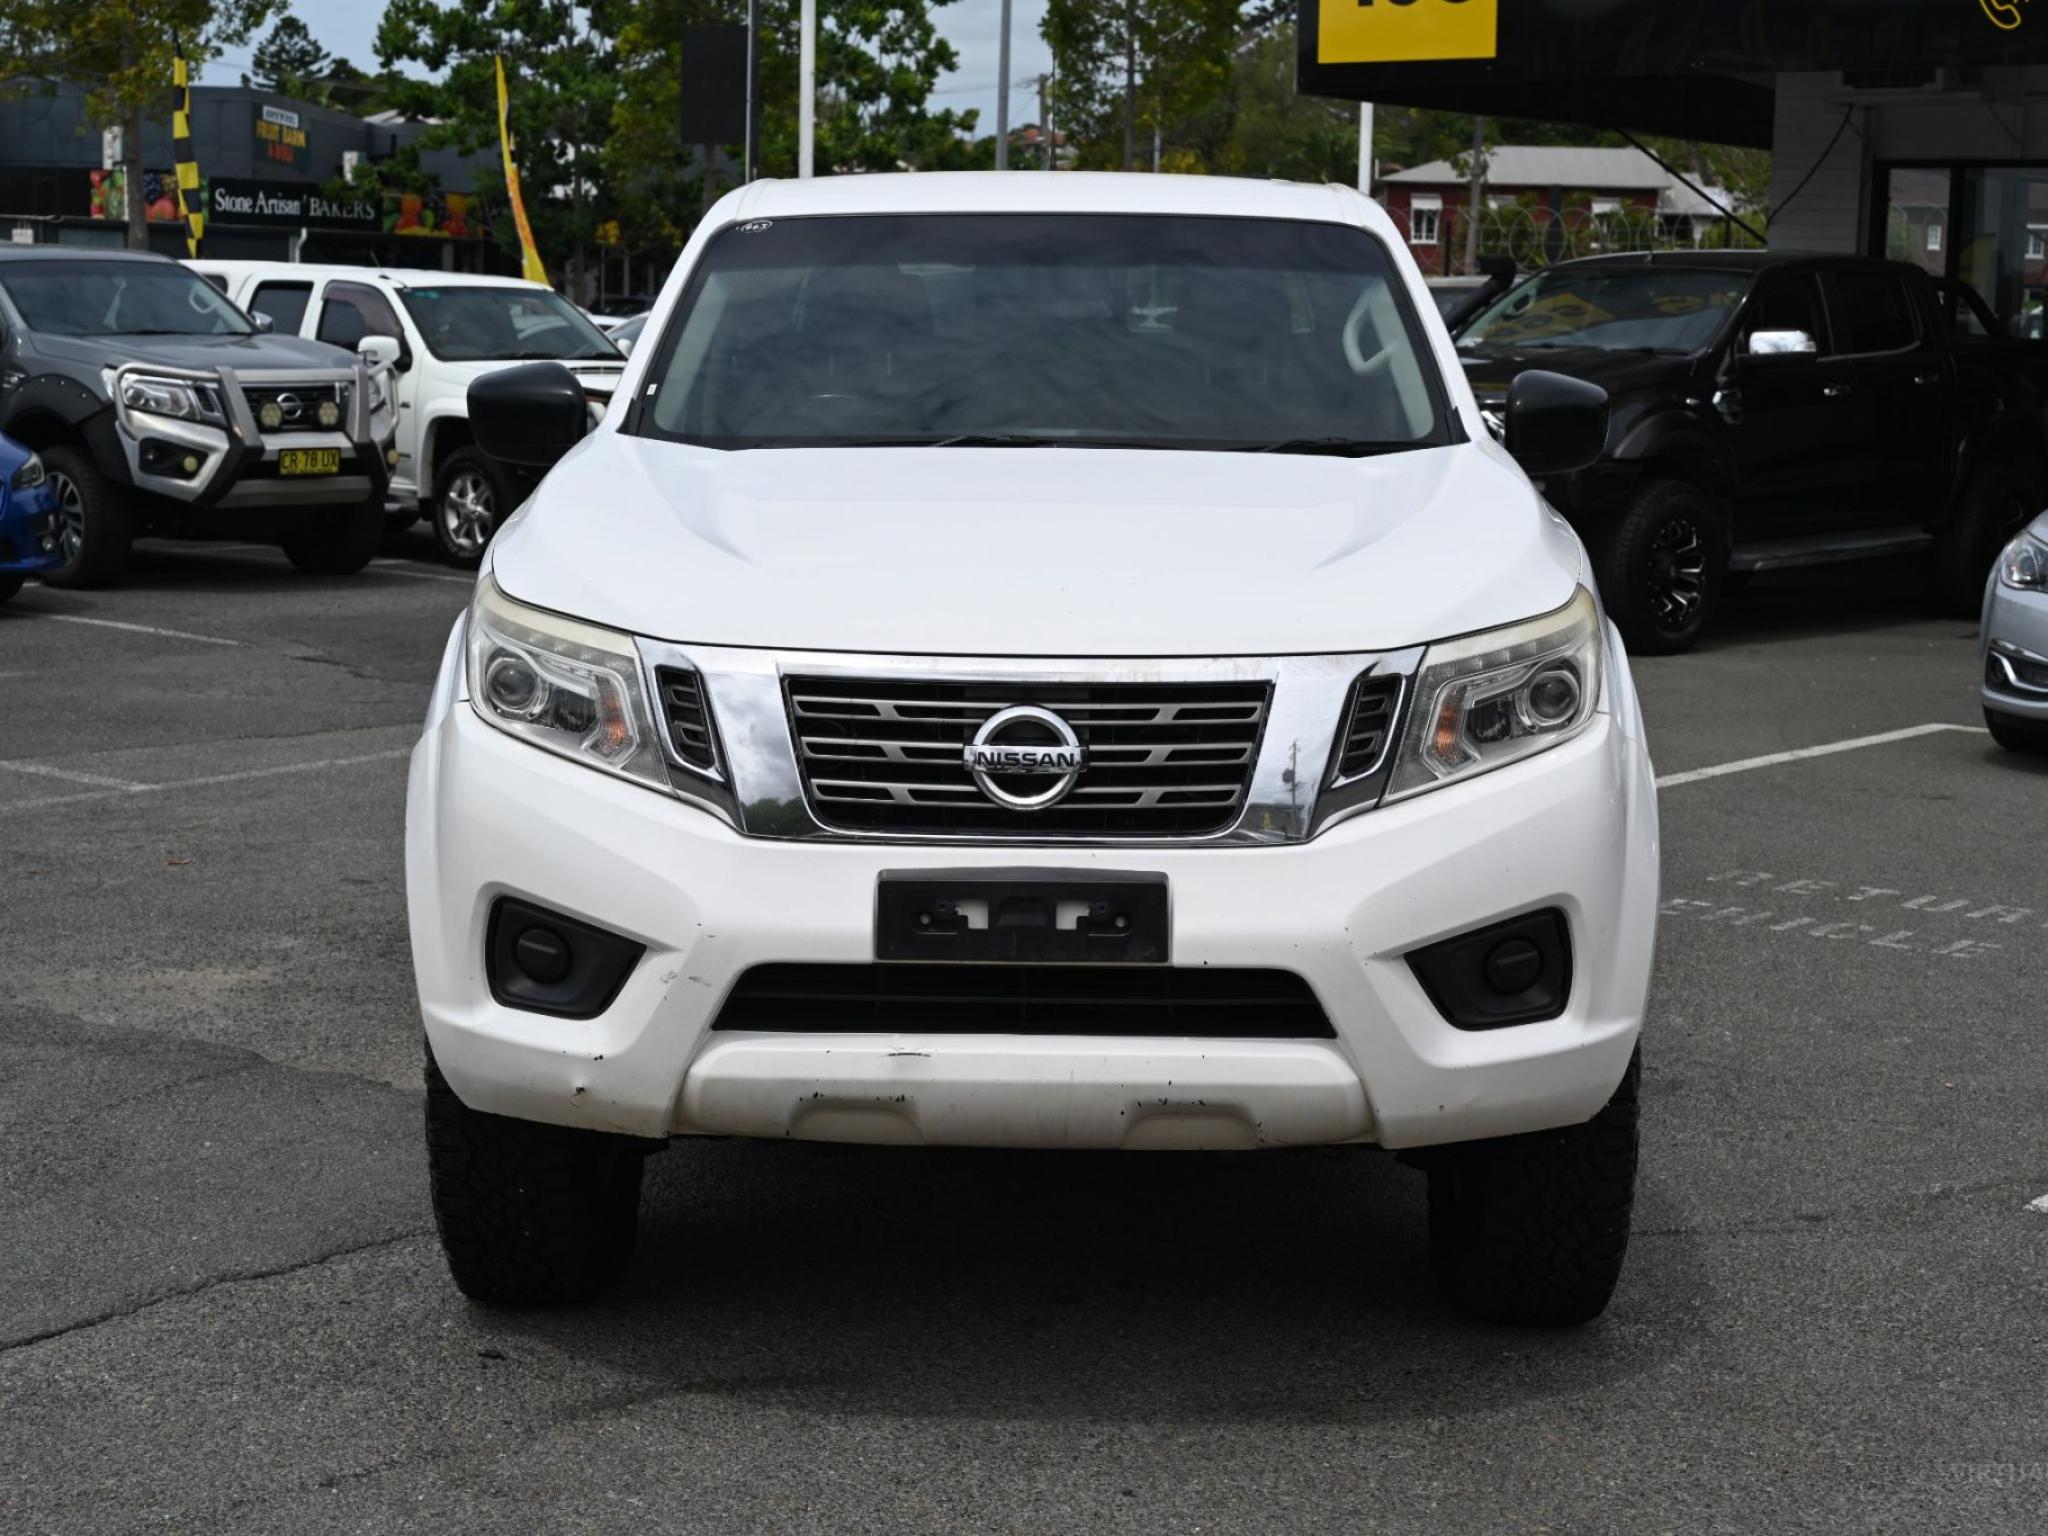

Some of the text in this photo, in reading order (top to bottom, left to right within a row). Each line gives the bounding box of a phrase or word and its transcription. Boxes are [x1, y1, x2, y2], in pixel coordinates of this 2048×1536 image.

[214, 188, 253, 213] Stone
[255, 190, 300, 216] Artisan
[977, 751, 1074, 768] NISSAN
[1660, 897, 2004, 959] EHICLE
